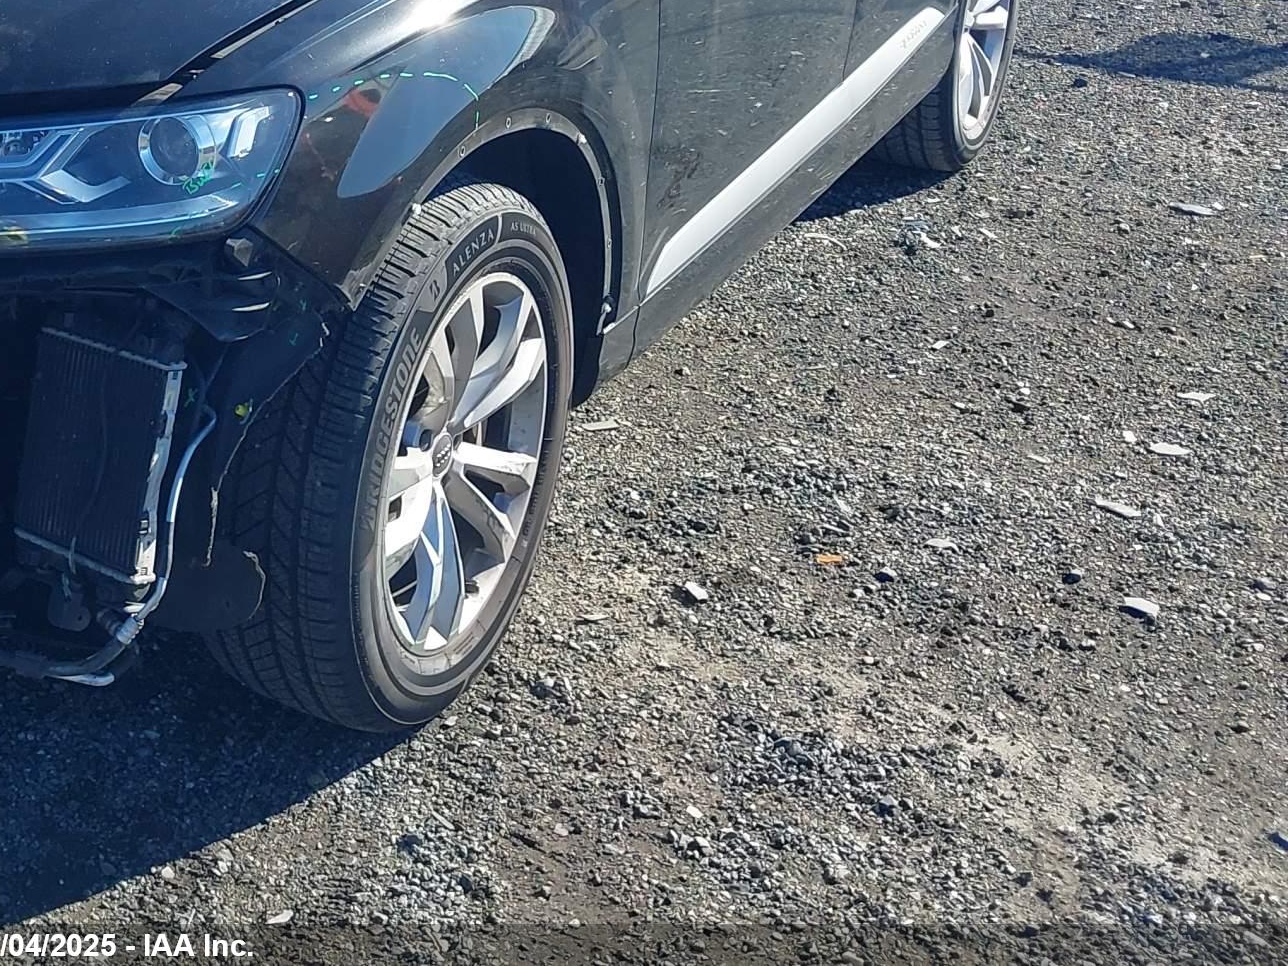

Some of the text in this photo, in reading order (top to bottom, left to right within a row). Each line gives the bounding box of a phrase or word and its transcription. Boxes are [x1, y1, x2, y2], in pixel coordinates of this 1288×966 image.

[510, 221, 519, 232] AS
[451, 227, 495, 276] ALENZA
[360, 327, 422, 533] BRIDGESTONE
